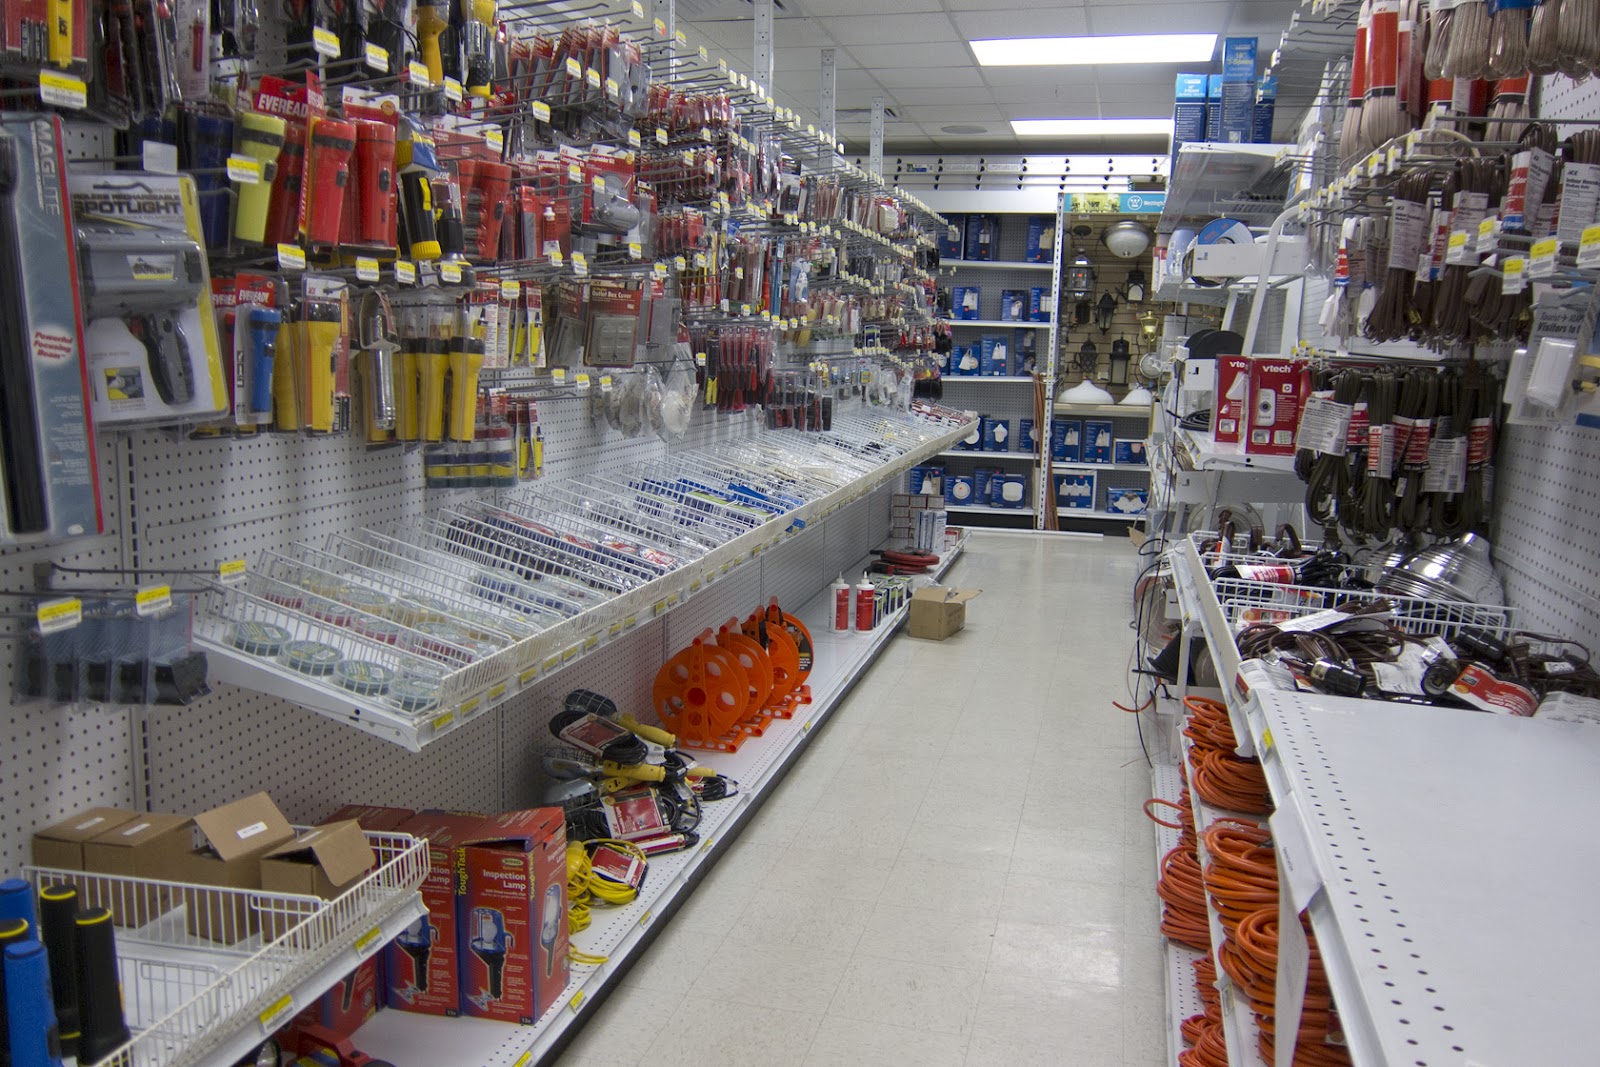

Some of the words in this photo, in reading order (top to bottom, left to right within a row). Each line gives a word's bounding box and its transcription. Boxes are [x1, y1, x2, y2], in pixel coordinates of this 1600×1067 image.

[258, 93, 308, 118] EVEREAD
[212, 294, 235, 305] EVEREA
[238, 289, 269, 303] EVEREADY
[35, 331, 73, 344] Powerful
[33, 340, 71, 353] Focusing
[1262, 365, 1291, 373] vtech
[458, 847, 468, 897] ToughTask
[482, 869, 526, 880] Inspection
[502, 880, 527, 891] Lamp
